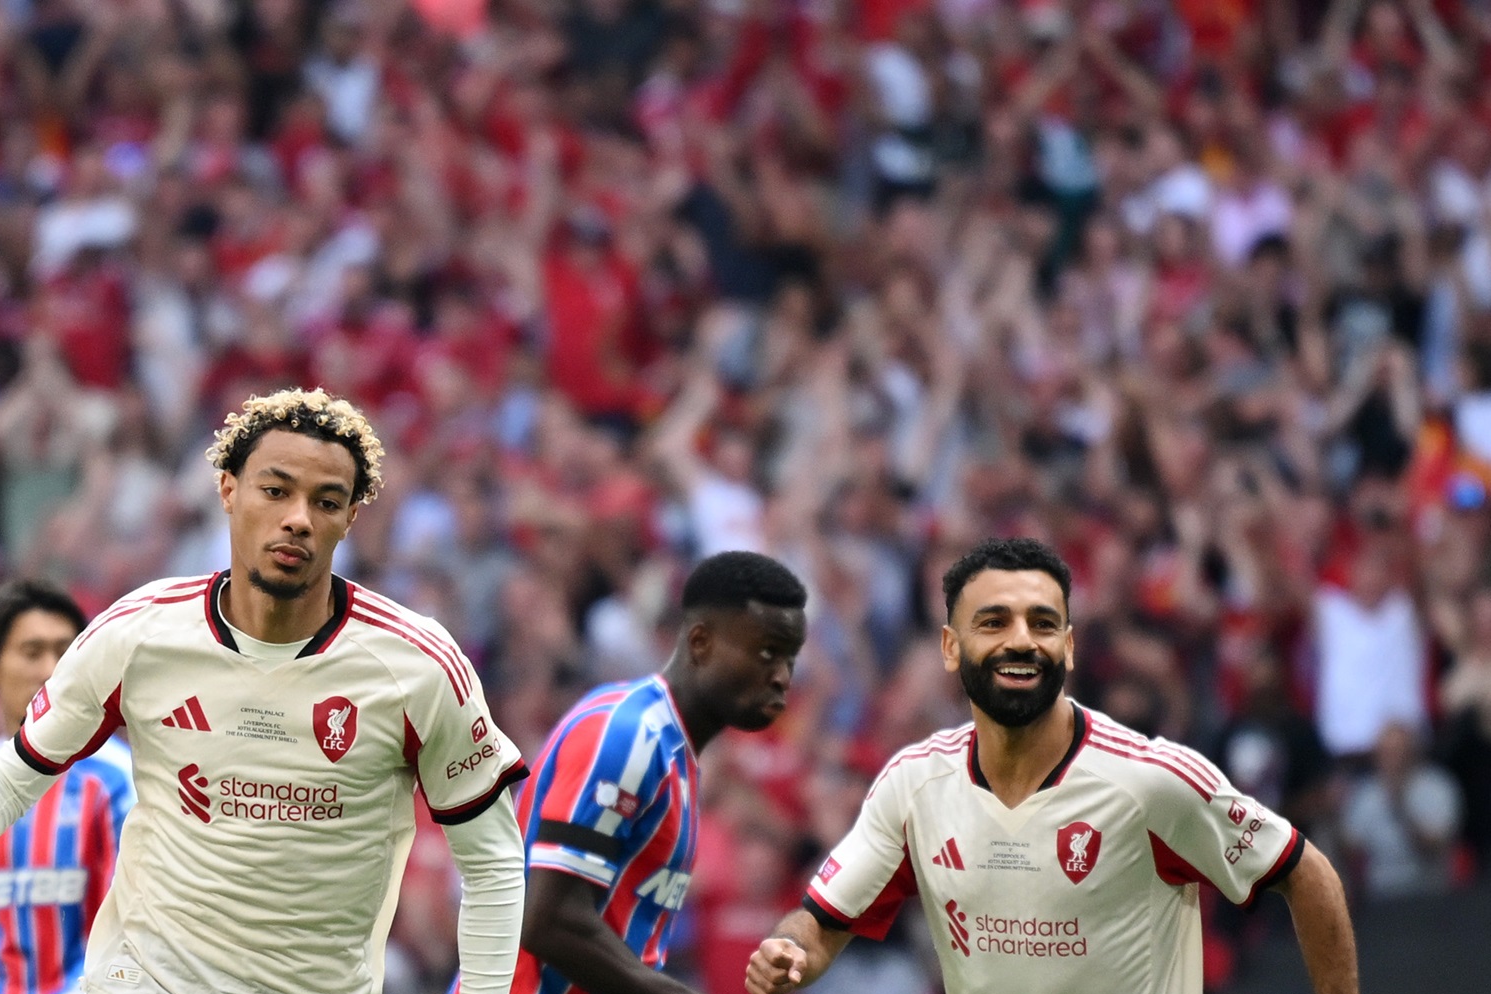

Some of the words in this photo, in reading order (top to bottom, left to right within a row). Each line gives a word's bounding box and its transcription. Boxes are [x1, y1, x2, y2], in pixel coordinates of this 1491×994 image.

[240, 706, 264, 714] CRYSTAL
[264, 709, 285, 717] PALACE
[243, 719, 273, 728] LIVERPOOL
[244, 732, 277, 741] COMMUNITY
[219, 777, 338, 803] standard
[220, 798, 344, 822] chartered
[975, 914, 1079, 937] standard
[976, 935, 1088, 957] chartered
